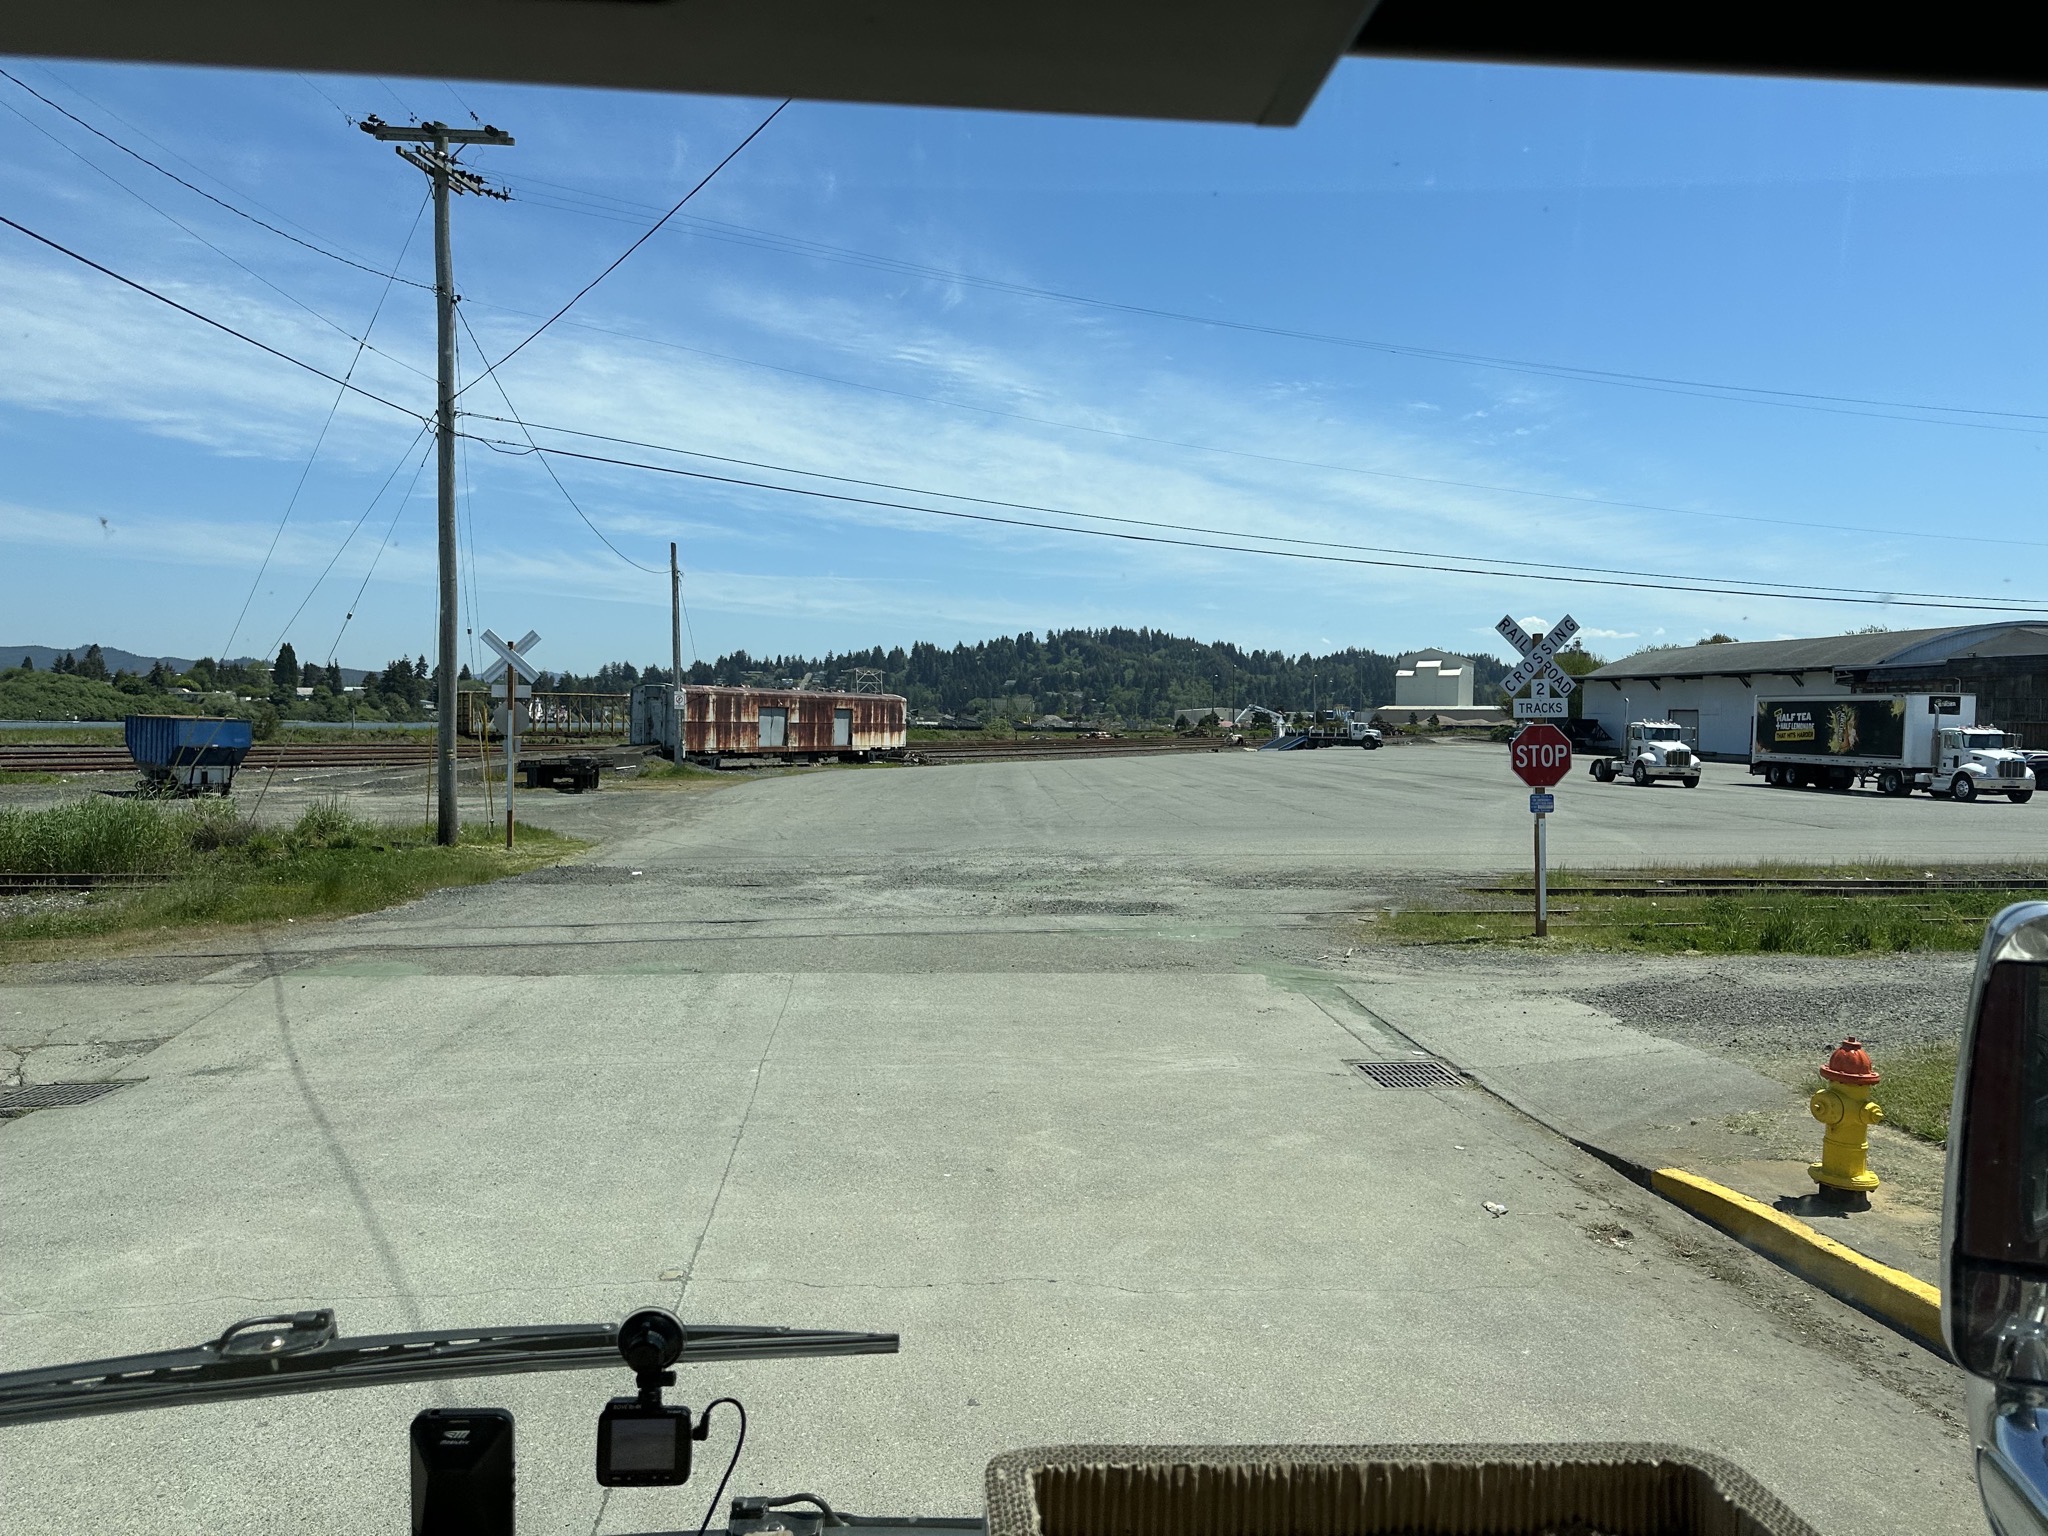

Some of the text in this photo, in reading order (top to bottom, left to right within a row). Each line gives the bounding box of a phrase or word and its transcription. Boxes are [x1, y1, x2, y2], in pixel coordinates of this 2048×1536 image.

[1498, 618, 1572, 694] RAIL ROAD
[1505, 620, 1576, 692] CROSSING
[1536, 682, 1545, 695] 2
[1518, 702, 1563, 713] TRACKS
[1776, 712, 1812, 722] HALF TEA
[1791, 722, 1815, 730] LEMONADE
[1515, 744, 1568, 768] STOP
